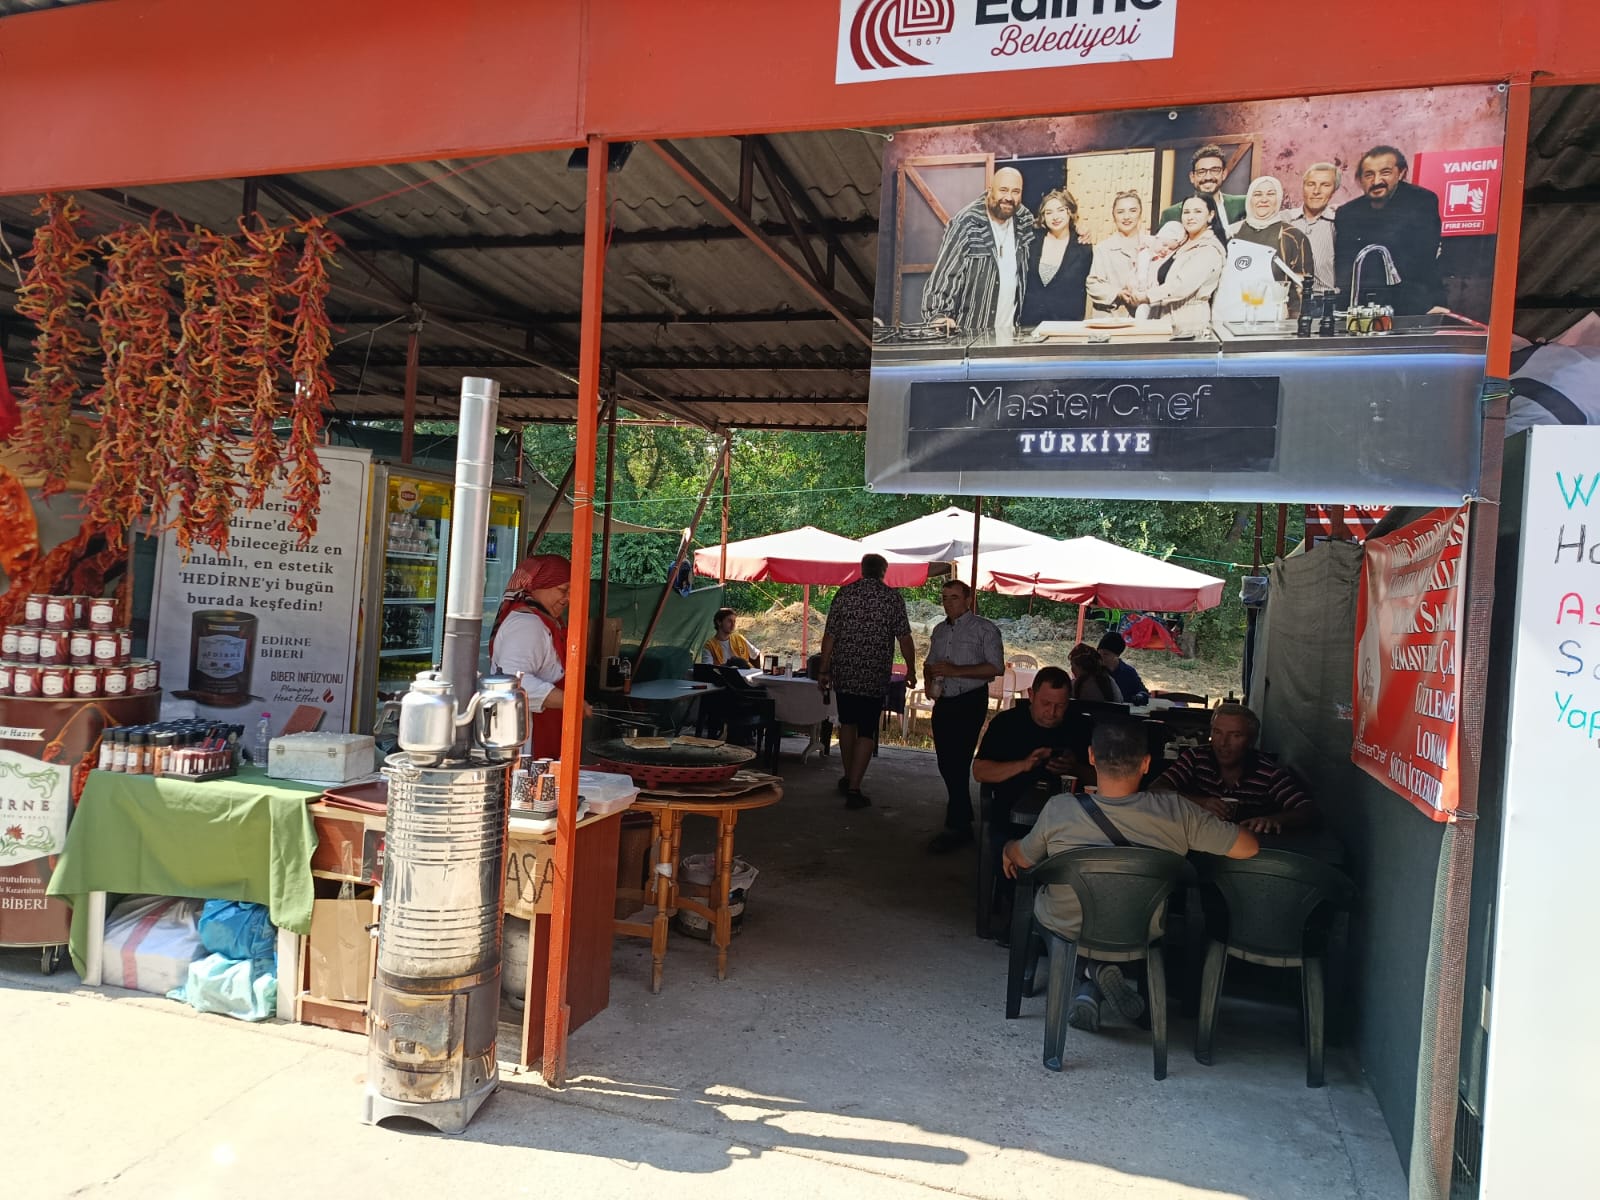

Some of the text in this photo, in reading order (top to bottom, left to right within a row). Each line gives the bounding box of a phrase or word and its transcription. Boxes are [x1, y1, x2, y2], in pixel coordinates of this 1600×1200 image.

[906, 36, 942, 48] 1867
[990, 17, 1141, 57] Belediyesi
[1443, 159, 1498, 174] YANGIN
[1445, 222, 1461, 230] FIRE
[967, 384, 1214, 422] MasterChef
[1020, 430, 1151, 453] TÜRKİYE
[324, 546, 342, 555] en
[181, 554, 334, 574] anlamlı, en estetik
[286, 579, 334, 595] bugün
[187, 593, 323, 611] burada keşfedin!
[262, 635, 312, 647] EDİRNE
[2, 896, 48, 910] BİBERİ
